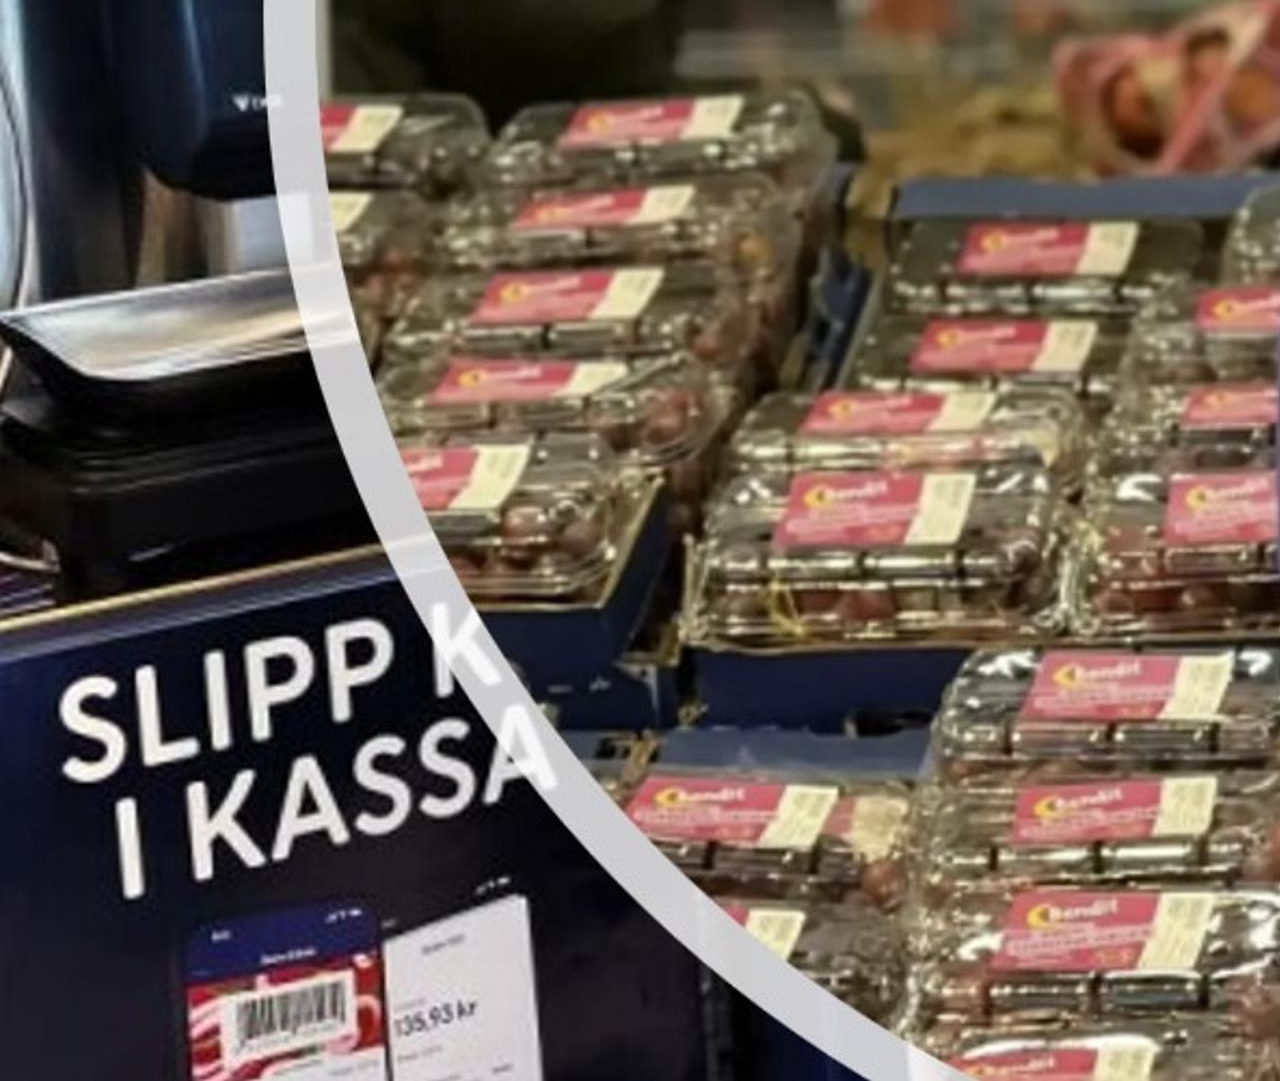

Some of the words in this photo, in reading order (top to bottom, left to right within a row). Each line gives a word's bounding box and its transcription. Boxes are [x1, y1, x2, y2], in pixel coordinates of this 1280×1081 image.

[58, 618, 395, 784] SLIPP
[115, 797, 145, 900] I
[187, 703, 560, 882] KASSA
[457, 998, 478, 1020] kr
